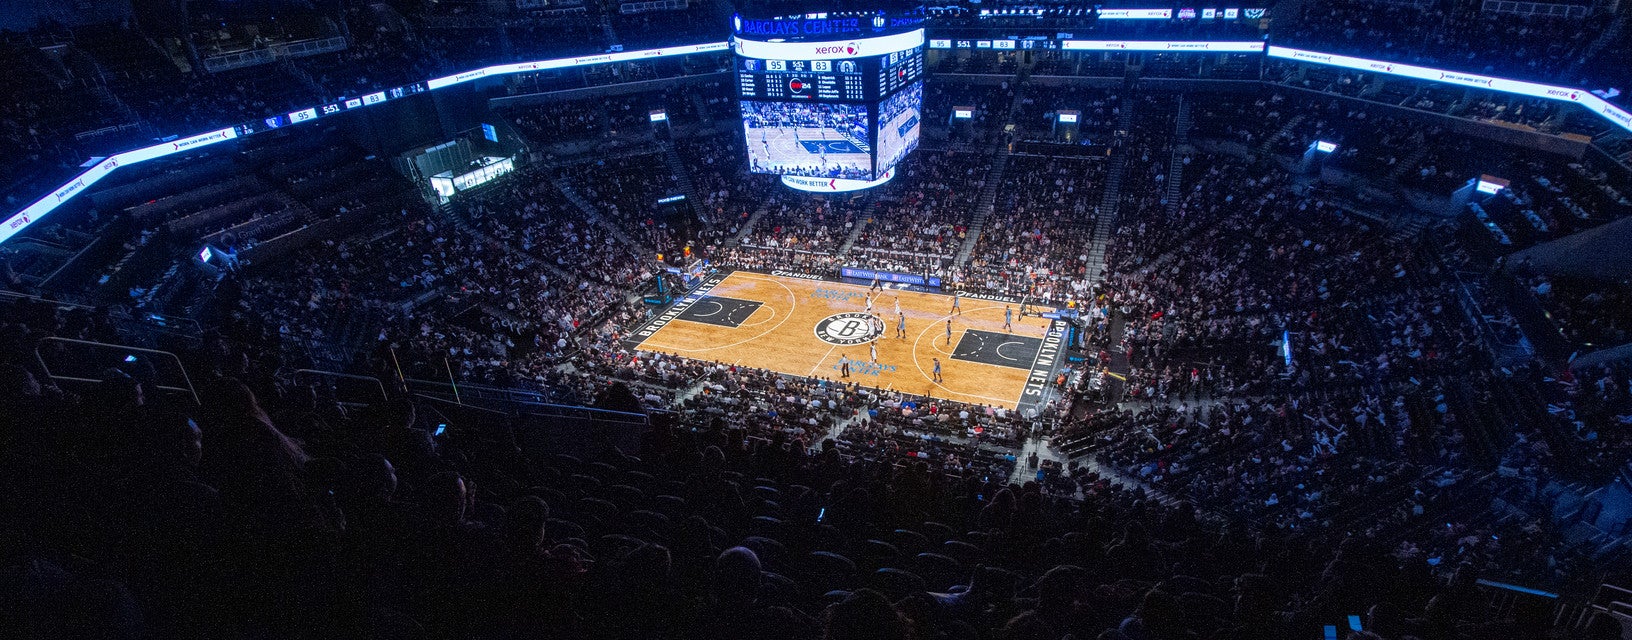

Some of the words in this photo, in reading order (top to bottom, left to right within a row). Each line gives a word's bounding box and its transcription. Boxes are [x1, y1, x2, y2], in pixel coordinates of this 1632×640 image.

[744, 20, 799, 35] BARCLAYS
[803, 18, 861, 34] CENTER
[815, 46, 844, 55] xerox
[770, 61, 782, 70] 95
[815, 61, 827, 71] 83
[1547, 89, 1569, 98] xerox
[369, 95, 380, 103] 83
[298, 112, 309, 120] 95
[795, 178, 808, 186] WORK
[809, 180, 829, 188] BETTER
[782, 271, 824, 281] FANDUEL
[965, 292, 1017, 303] FANDUEL
[639, 297, 697, 337] BROOKLYN
[692, 278, 721, 297] NETS
[838, 320, 861, 337] B
[818, 330, 833, 342] NEW
[839, 335, 873, 345] YORK
[832, 365, 880, 377] CNTER
[1025, 369, 1049, 397] NETS
